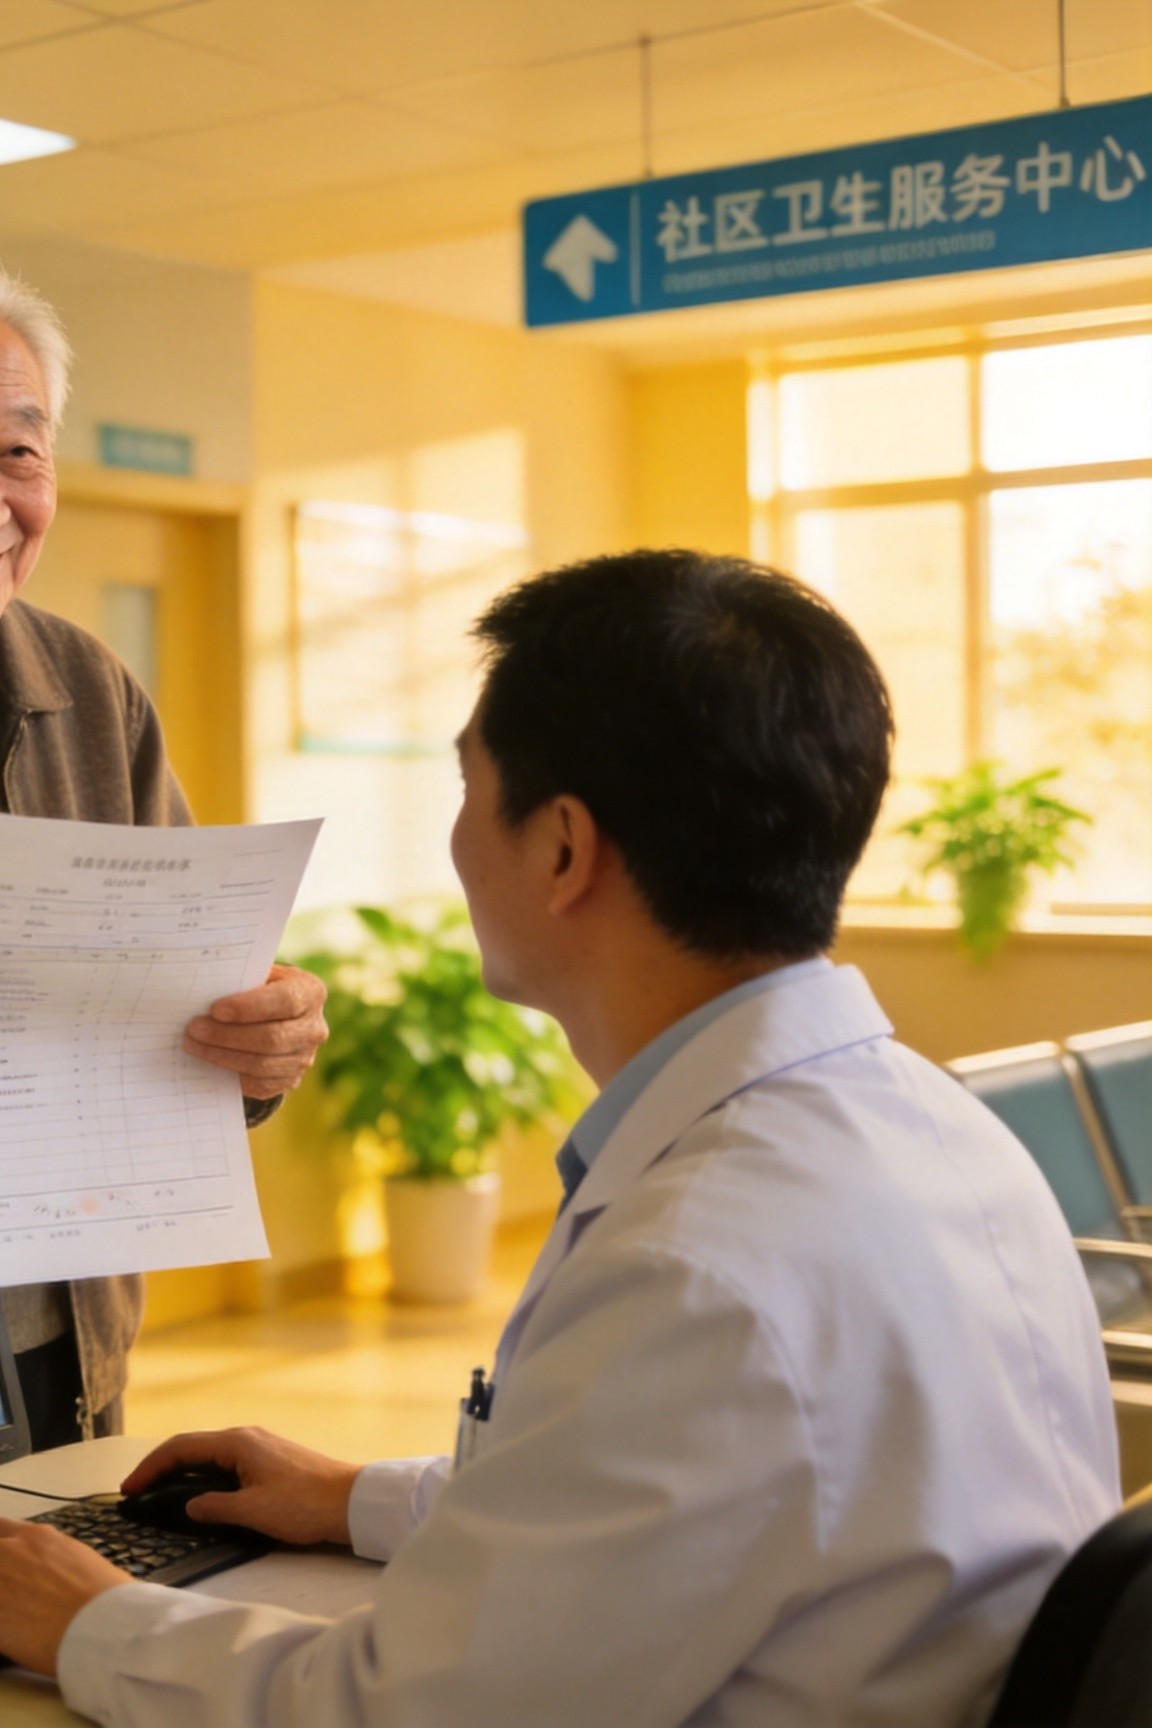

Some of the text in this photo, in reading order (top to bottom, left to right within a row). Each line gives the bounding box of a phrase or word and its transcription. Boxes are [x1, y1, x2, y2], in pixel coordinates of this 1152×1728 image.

[656, 135, 1146, 263] 社区卫生服务中心
